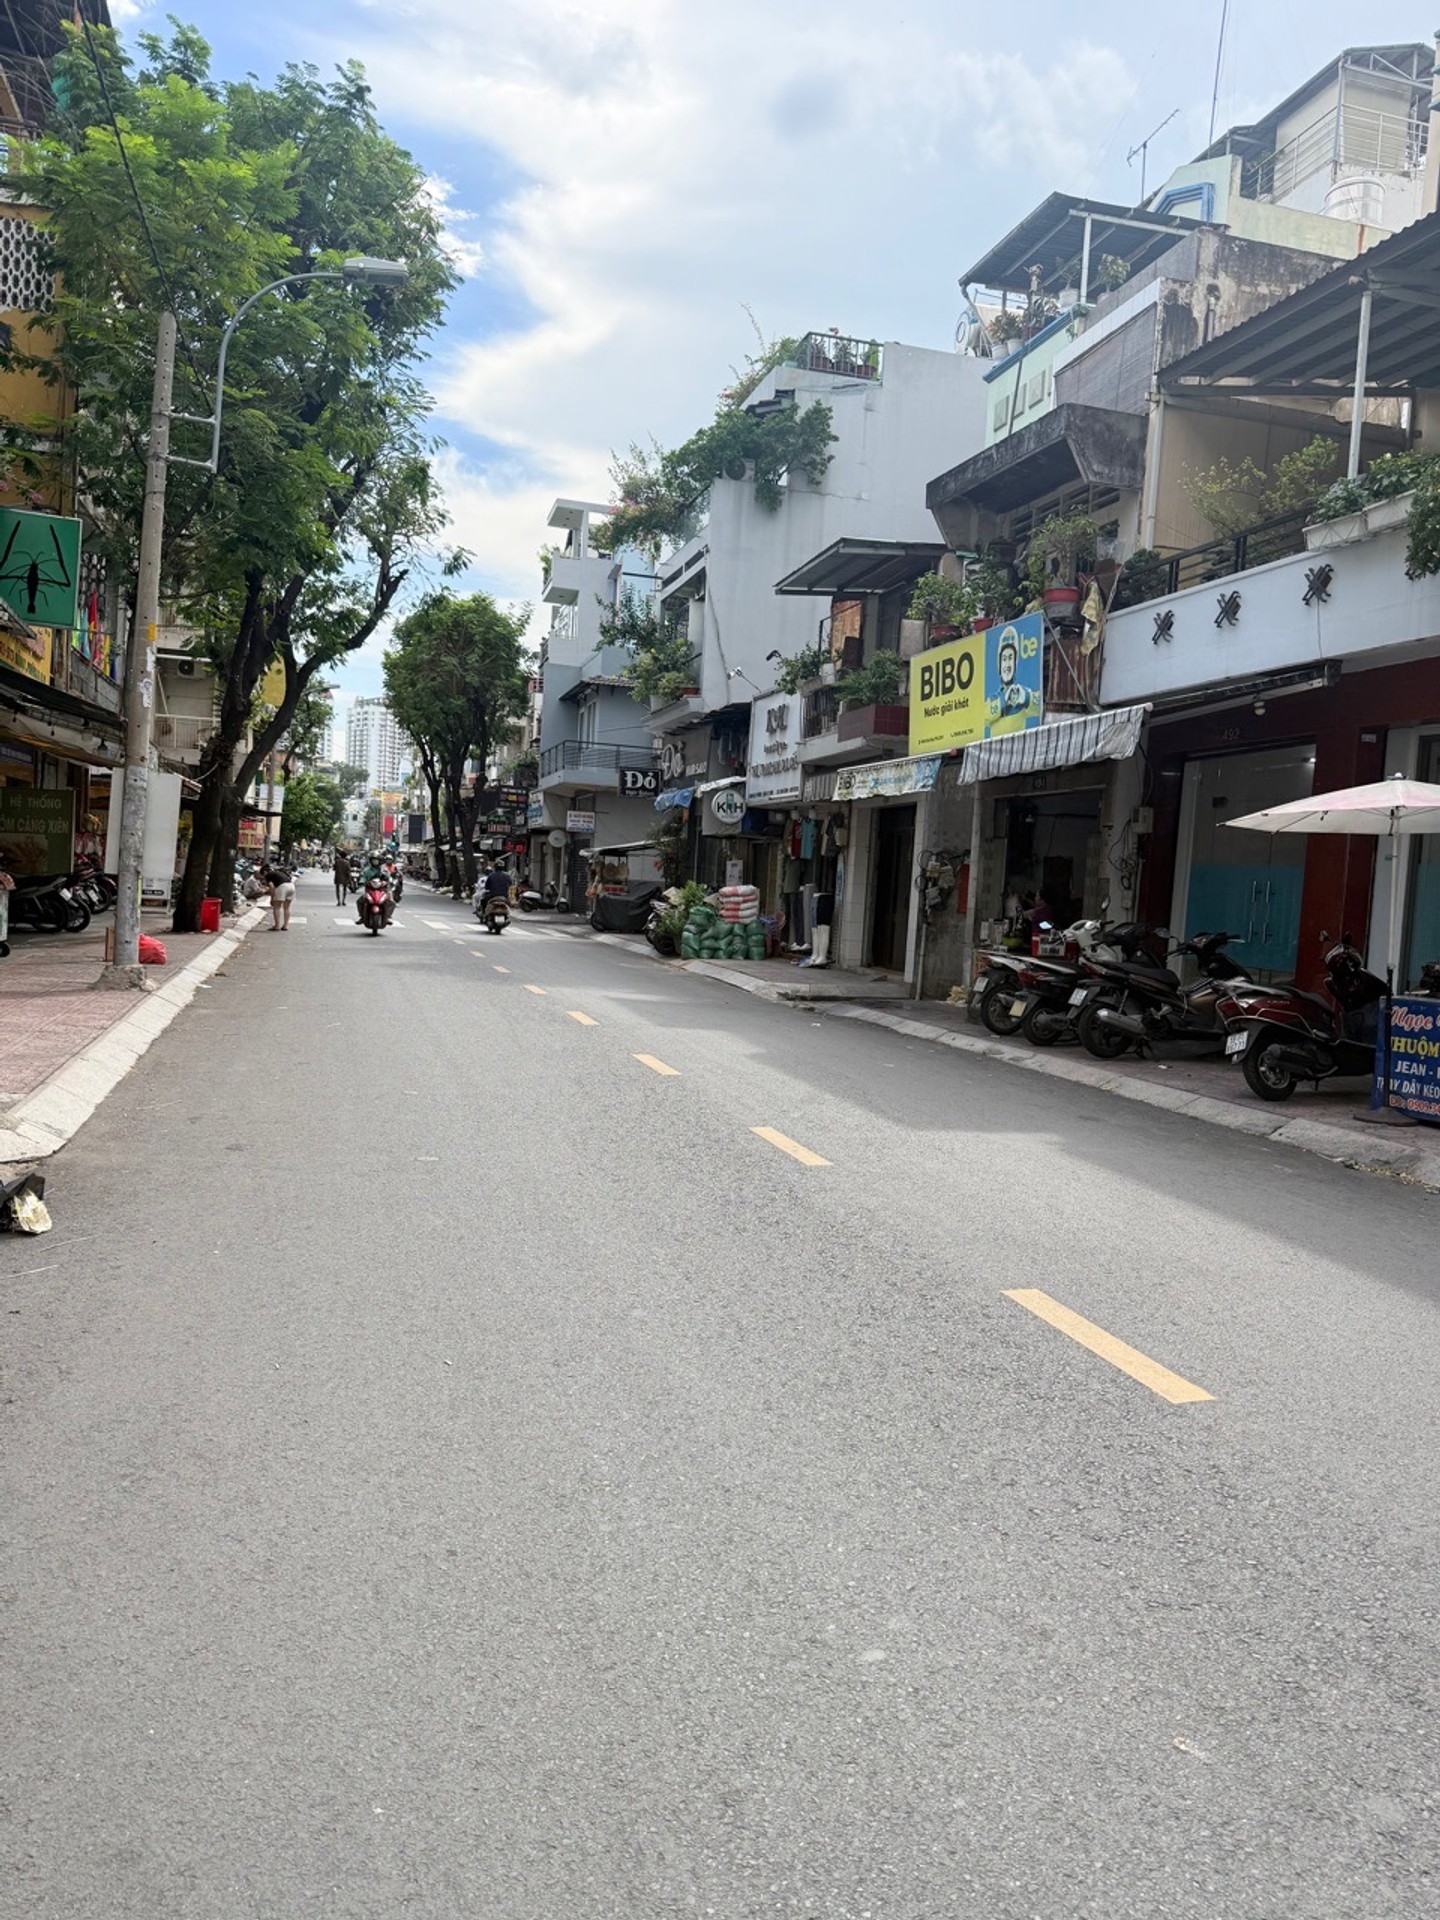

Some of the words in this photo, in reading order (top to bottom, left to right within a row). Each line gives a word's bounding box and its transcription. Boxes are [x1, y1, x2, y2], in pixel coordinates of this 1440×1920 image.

[1021, 634, 1038, 659] be
[921, 652, 974, 701] BIBO
[941, 701, 954, 716] giải
[954, 698, 969, 713] khát
[624, 771, 657, 789] Đỏ
[28, 794, 62, 809] THỐNG
[1391, 1036, 1440, 1060] HUỘM
[1394, 1060, 1427, 1077] JEAN
